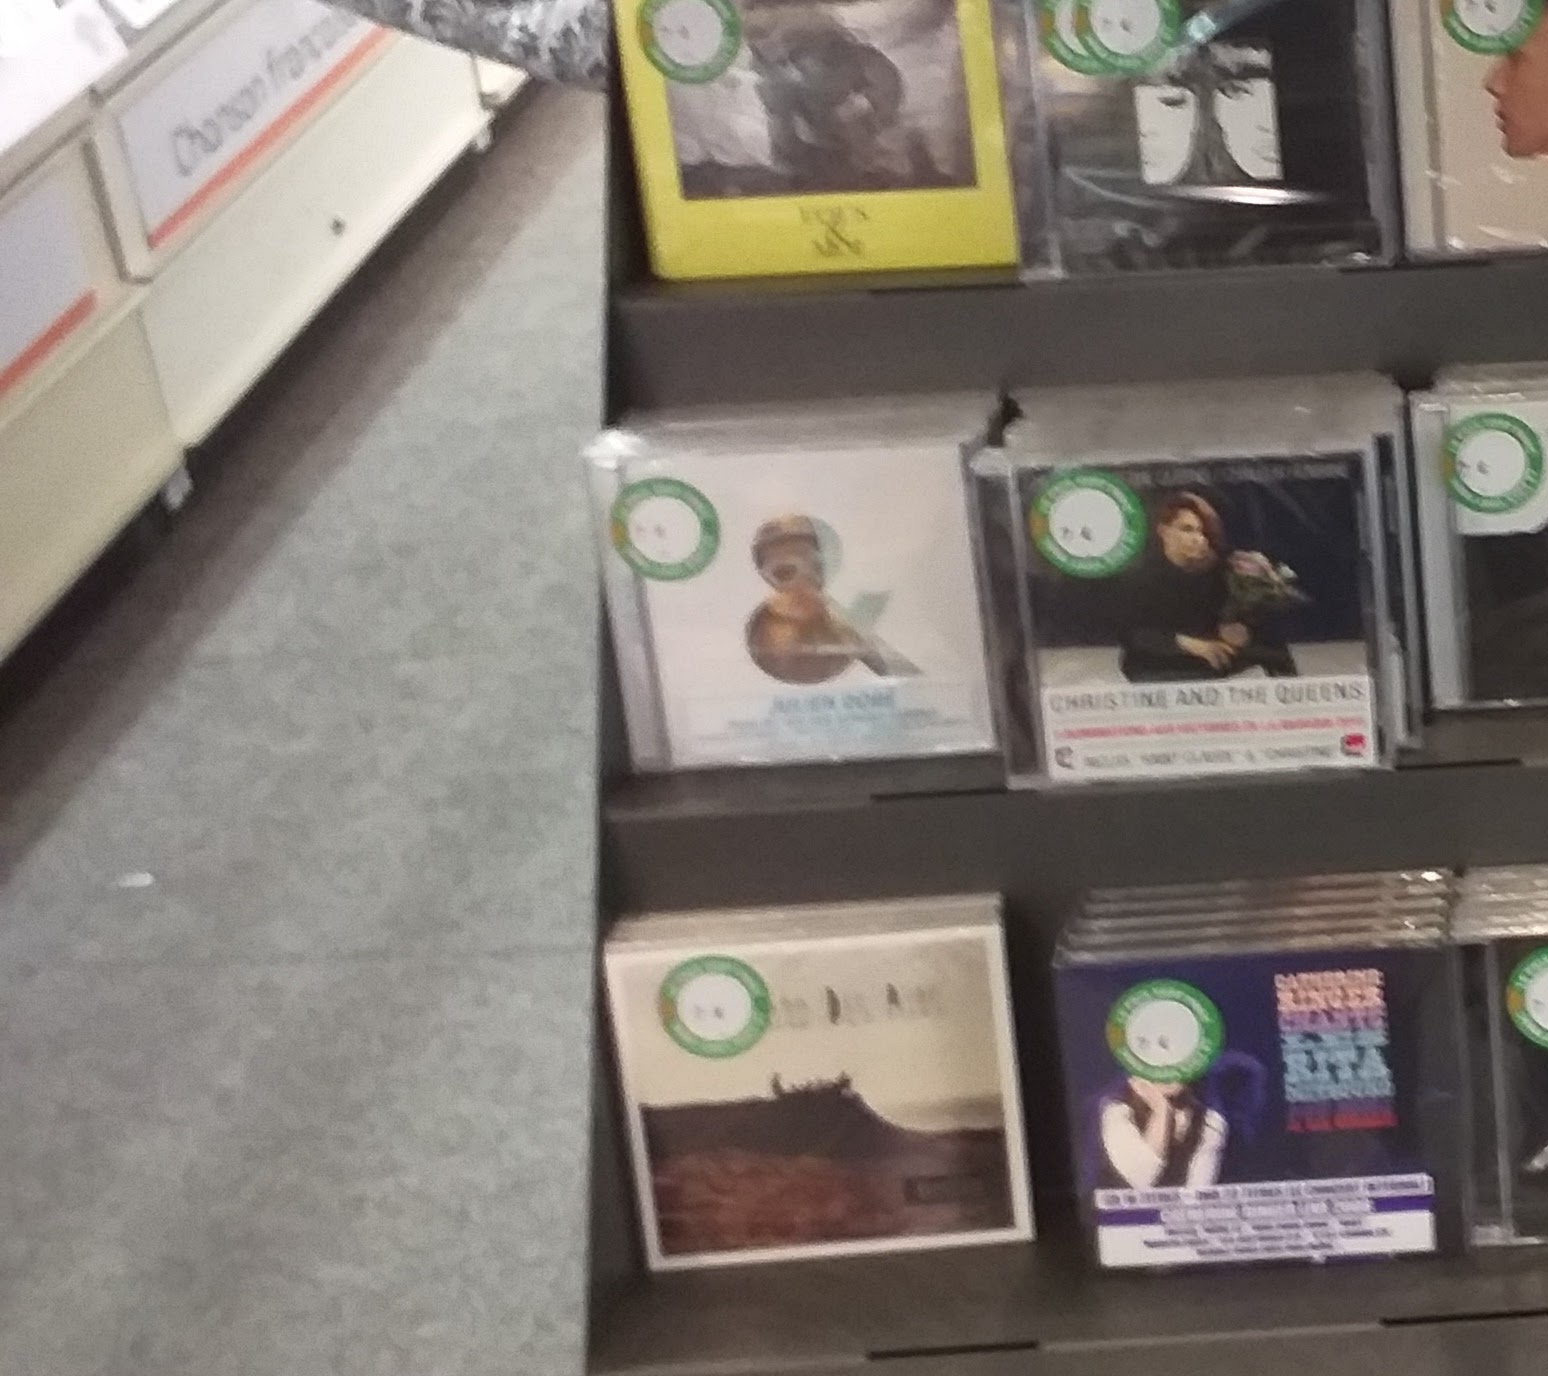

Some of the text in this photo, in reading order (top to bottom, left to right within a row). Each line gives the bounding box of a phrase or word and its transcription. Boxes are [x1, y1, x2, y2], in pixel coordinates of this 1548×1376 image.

[1049, 680, 1366, 714] CHRISTINE AND THE QUEENS
